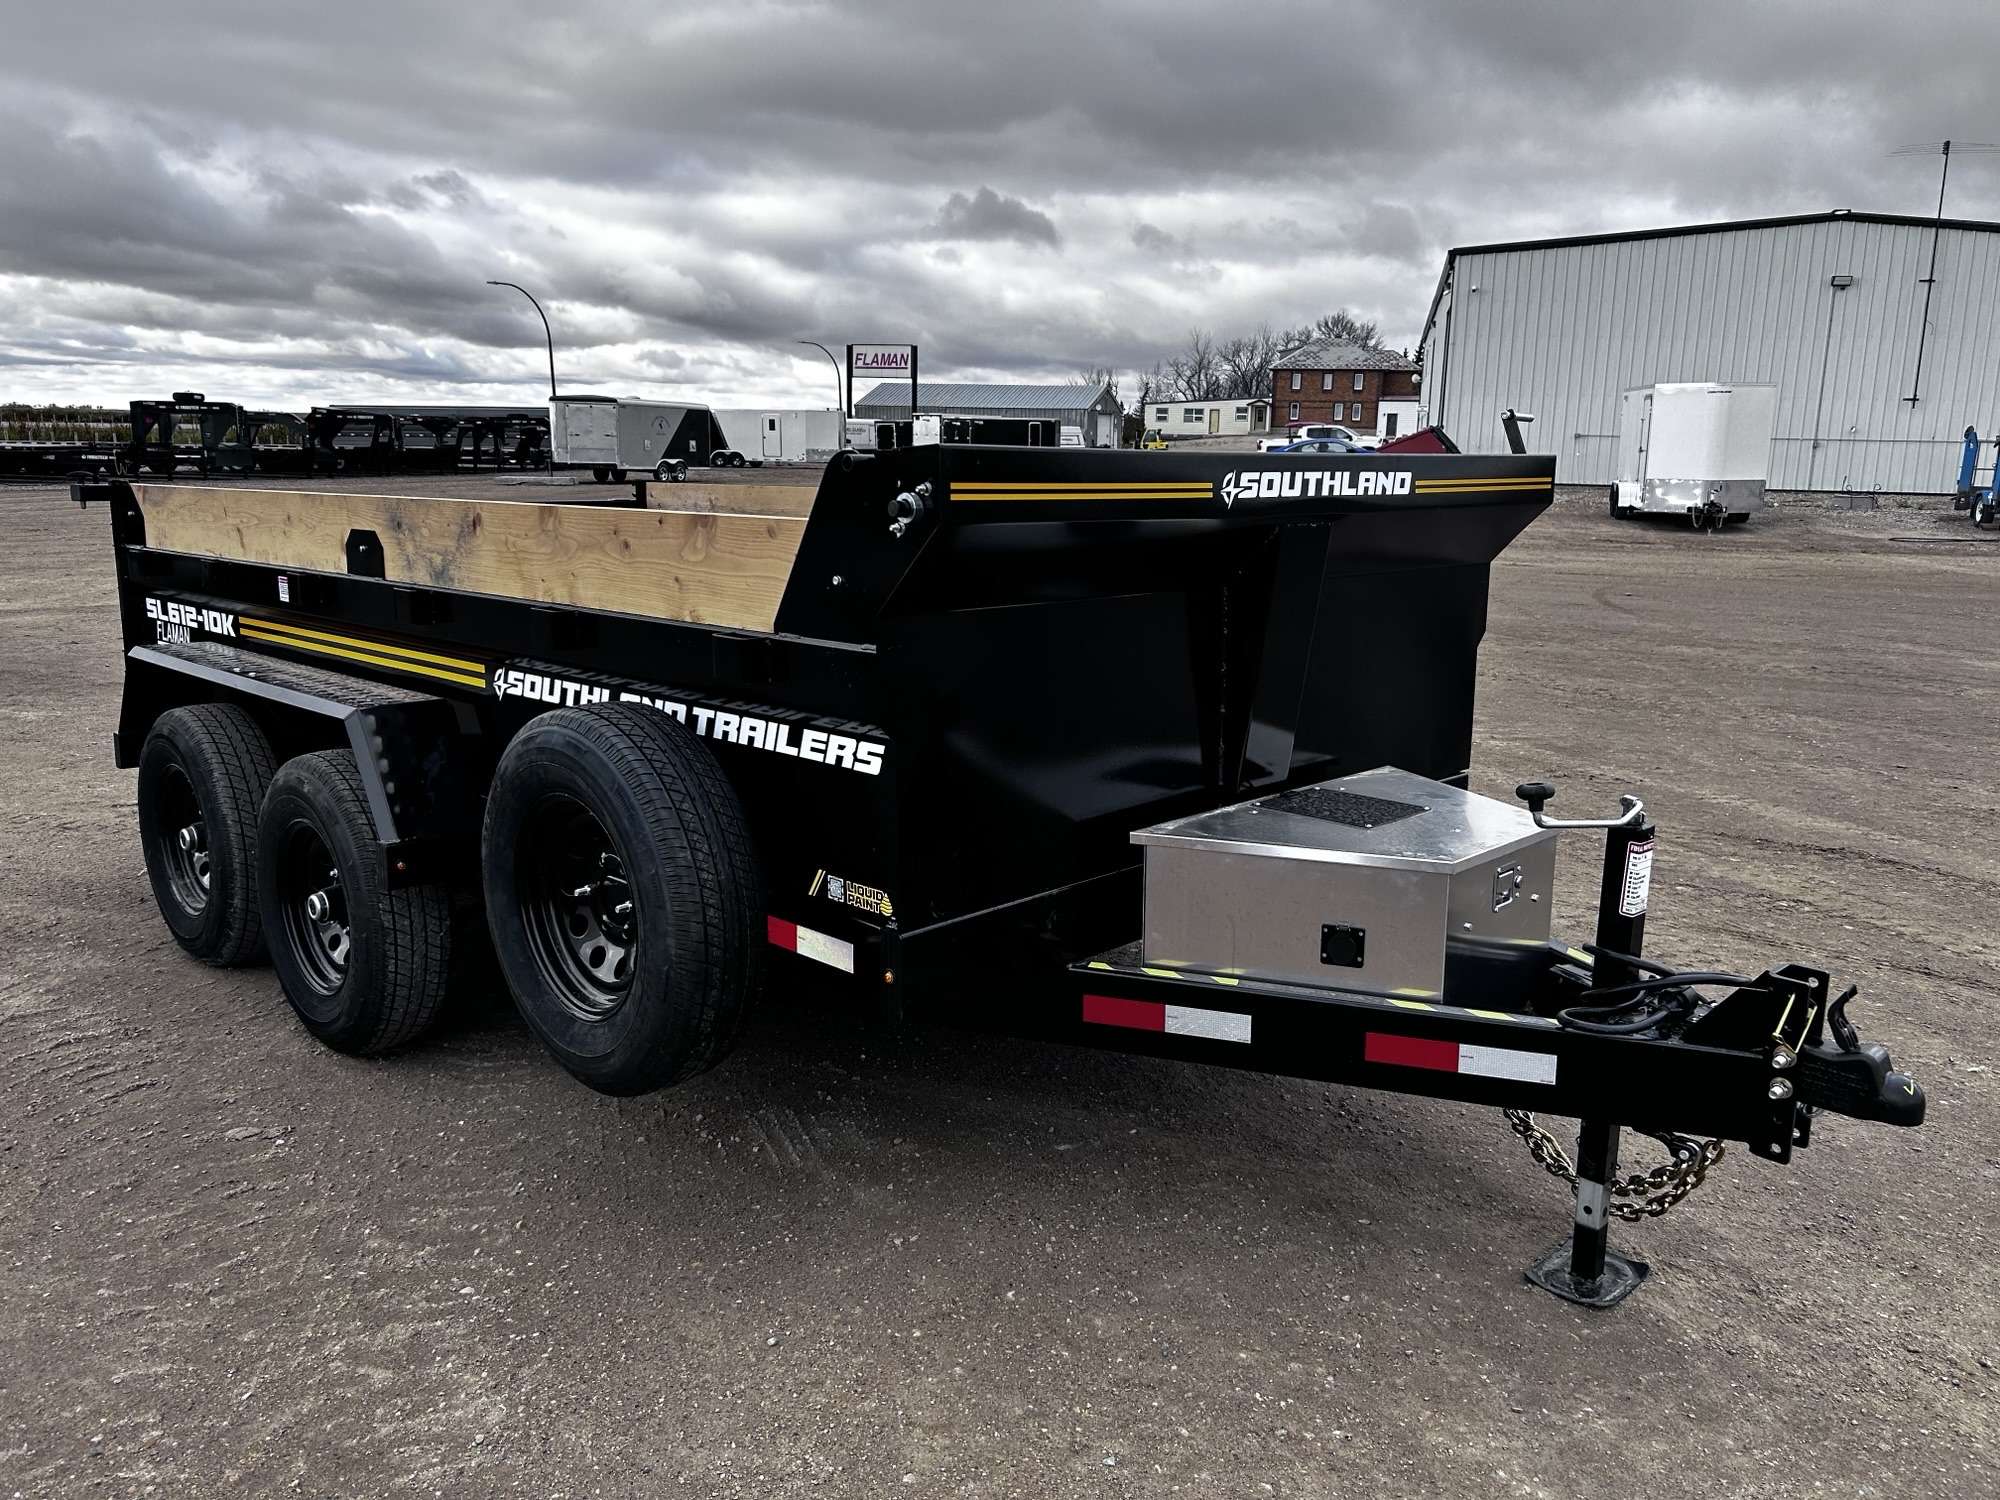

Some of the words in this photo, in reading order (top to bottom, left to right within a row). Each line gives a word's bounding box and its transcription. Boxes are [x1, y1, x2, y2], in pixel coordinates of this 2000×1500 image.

[855, 353, 909, 366] FLAMAN
[1238, 471, 1412, 498] SOUTHLAND
[145, 597, 236, 637] SL612-10K
[156, 620, 191, 644] FLAMAN
[692, 706, 886, 776] TRAILERS
[846, 881, 884, 902] LIQUID
[847, 893, 880, 914] PAINT
